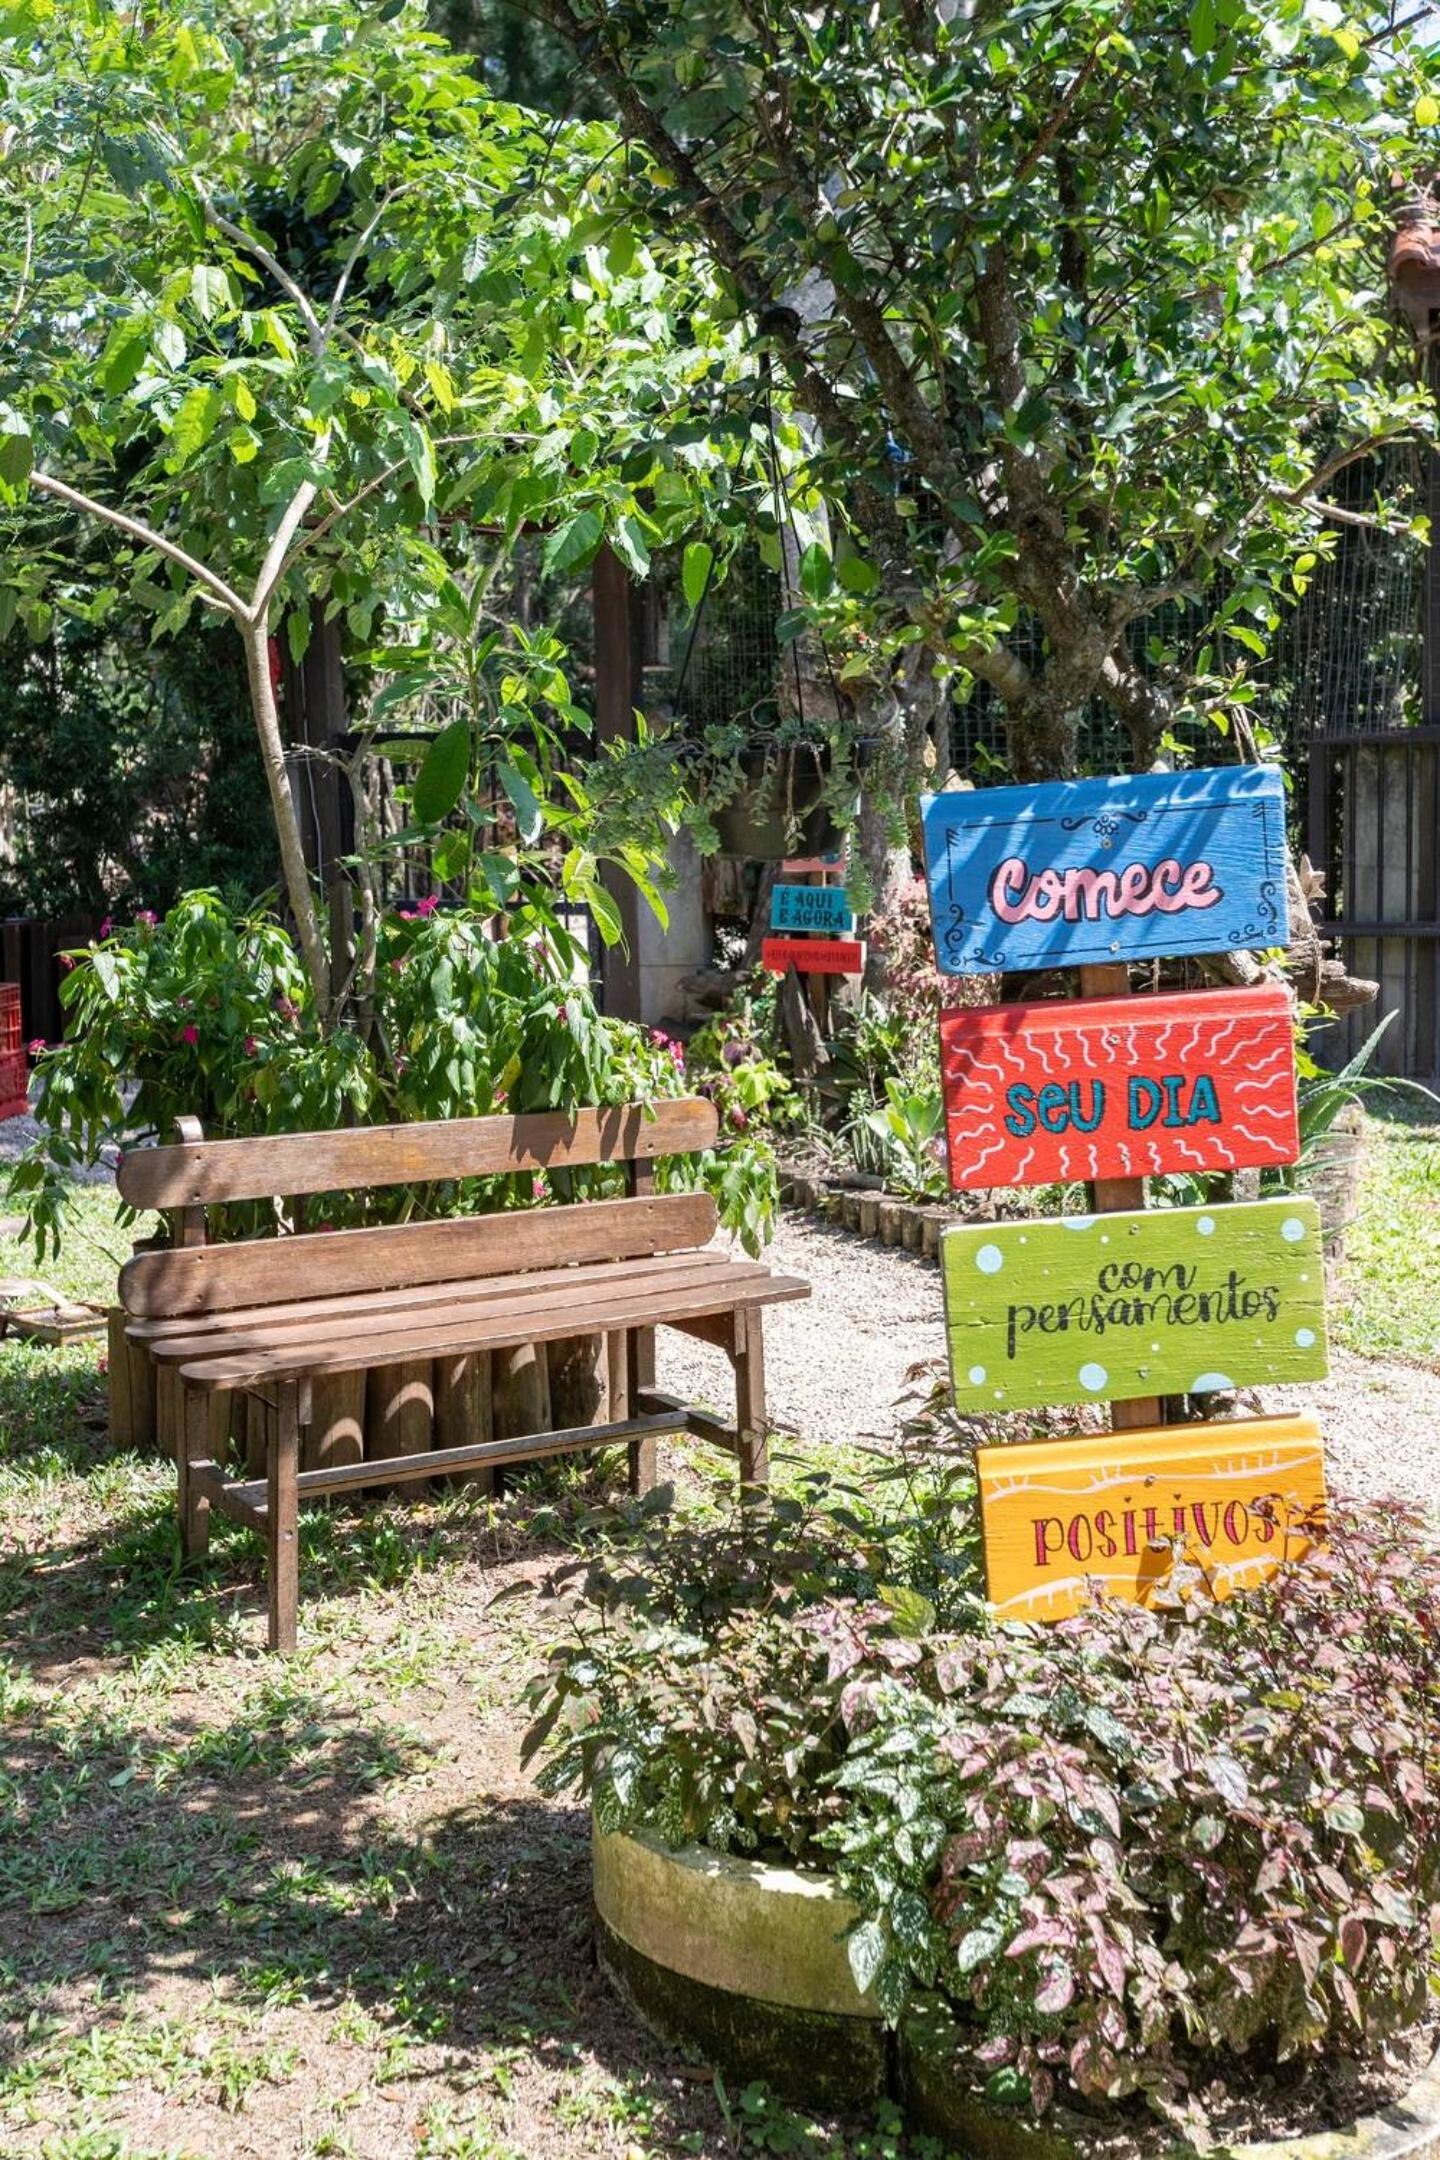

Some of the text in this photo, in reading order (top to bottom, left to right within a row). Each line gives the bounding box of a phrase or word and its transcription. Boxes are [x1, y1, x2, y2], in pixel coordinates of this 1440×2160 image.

[796, 891, 833, 909] AQUI
[987, 856, 1224, 925] Comece
[780, 908, 844, 928] E AGORA
[1127, 1074, 1223, 1131] DIA
[1098, 1260, 1198, 1294] com
[1005, 1270, 1281, 1359] pensamentos
